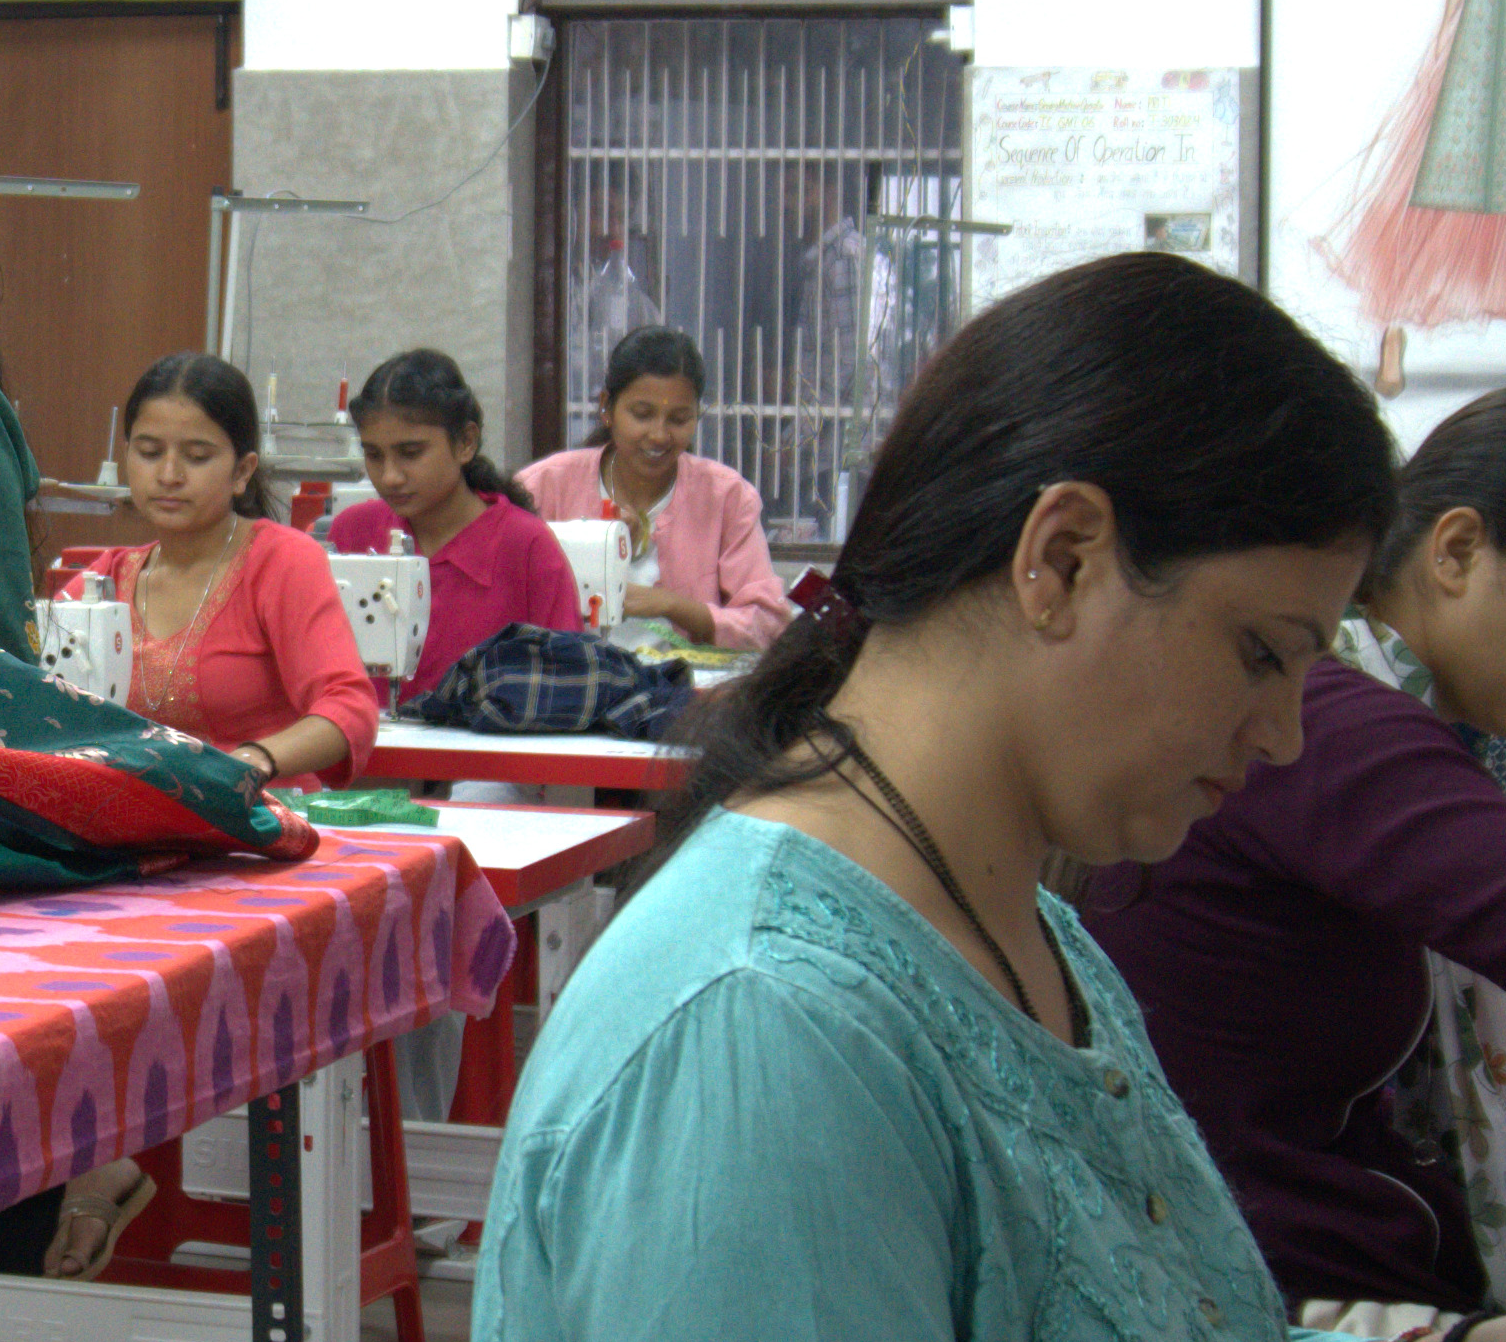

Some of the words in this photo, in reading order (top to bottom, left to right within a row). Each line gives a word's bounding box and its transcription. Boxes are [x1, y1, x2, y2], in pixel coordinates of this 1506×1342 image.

[998, 134, 1058, 169] Sequence
[1065, 134, 1085, 163] Of
[1092, 134, 1166, 167] Operation
[1173, 133, 1195, 162] In
